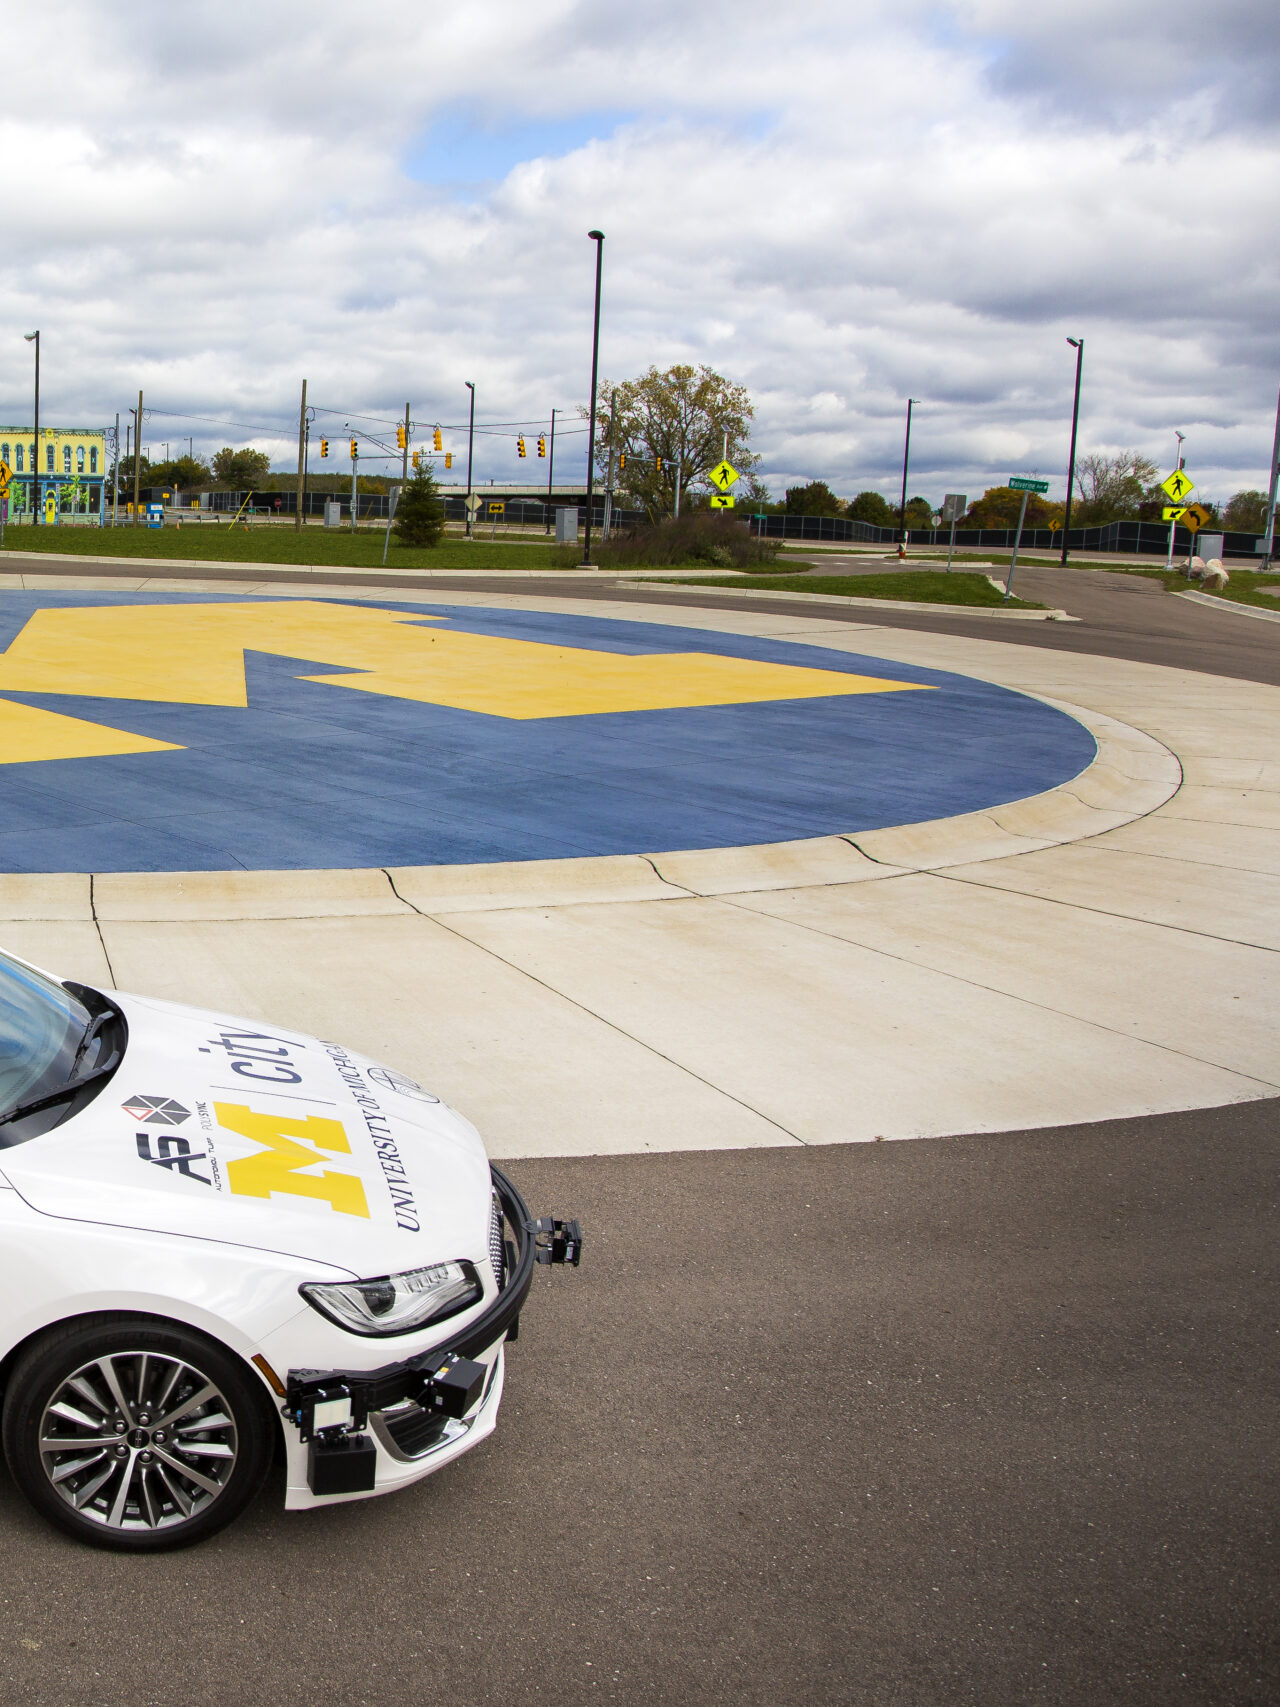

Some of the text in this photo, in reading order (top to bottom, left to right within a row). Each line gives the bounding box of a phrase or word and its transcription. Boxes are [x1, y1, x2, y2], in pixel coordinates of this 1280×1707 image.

[352, 1091, 380, 1110] OF
[212, 1101, 371, 1219] M
[362, 1109, 421, 1233] UNIVERSITY
